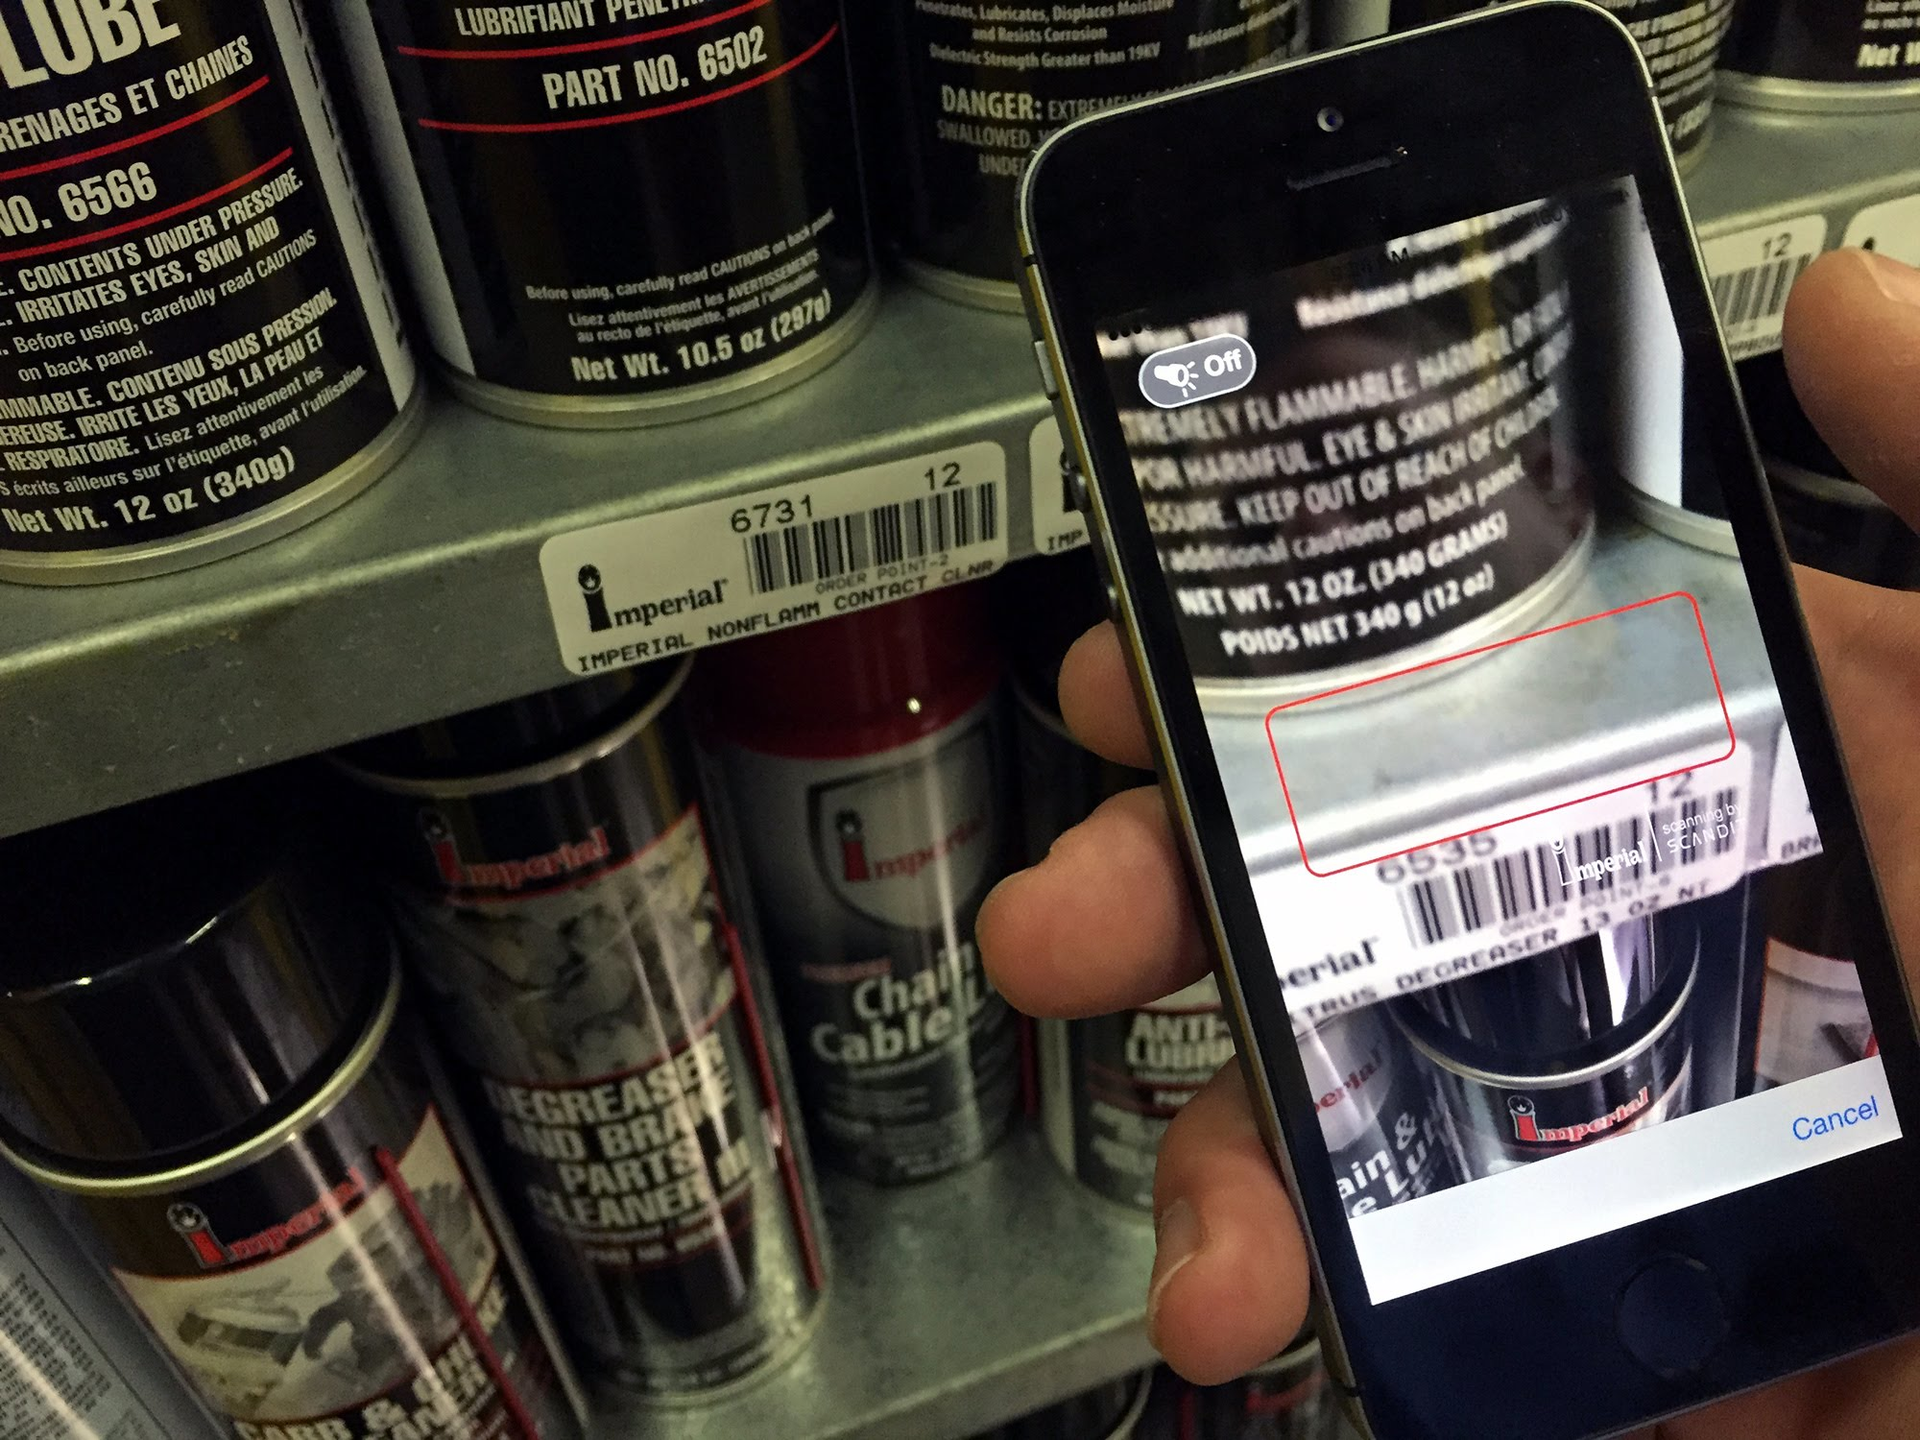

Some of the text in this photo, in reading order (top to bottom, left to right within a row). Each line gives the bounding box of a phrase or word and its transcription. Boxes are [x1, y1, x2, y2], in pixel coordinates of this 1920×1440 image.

[455, 0, 595, 36] LUBRIFIANT
[1044, 25, 1108, 43] Corrosion
[1052, 3, 1114, 23] Displaces
[0, 35, 253, 152] RENAGES ET CHAINES
[542, 25, 767, 109] PART NO. 6502
[1041, 52, 1091, 68] Greater
[941, 84, 1042, 120] DANGER:
[0, 161, 157, 238] NO. 6566
[18, 167, 303, 291] CONTENTS UNDER PRESSURE.
[15, 216, 279, 323] IRRITATES EYES, SKIN AND
[526, 286, 568, 300] Before
[572, 285, 614, 301] using,
[616, 274, 675, 297] carefully
[679, 267, 708, 287] read
[710, 245, 771, 278] CAUTIONS
[1763, 232, 1792, 260] 12
[13, 229, 316, 354] Before using, carefully read CAUTIONS
[569, 312, 605, 327] Lisez
[609, 297, 702, 324] attentivement
[18, 341, 154, 382] on back panel.
[106, 364, 206, 401] CONTENU
[208, 334, 260, 370] SOUS
[263, 287, 338, 340] PRESSION.
[571, 288, 832, 382] Net Wt. 10.5 oz (297g)
[1204, 349, 1243, 378] Off
[77, 410, 142, 437] IRRITE
[146, 395, 181, 423] LES
[187, 375, 240, 409] YEUX,
[242, 363, 266, 388] LA
[265, 343, 306, 378] PEAU
[302, 327, 324, 354] ET
[4, 364, 324, 472] RESPIRATOIRE. Lisez attentivement les
[13, 478, 60, 497] écrits
[63, 470, 129, 492] ailleurs
[133, 464, 161, 482] sur
[260, 413, 300, 441] avant
[2, 445, 296, 534] Net Wt. 12 oz (340g)
[731, 461, 962, 534] 6731 12
[1303, 475, 1356, 514] OUT
[1360, 464, 1391, 501] OF
[1177, 509, 1508, 617] NET WT. 12 OZ. (340 GRAMS)
[1292, 517, 1393, 560] cautions
[1395, 505, 1425, 534] on
[578, 559, 995, 673] IMPERIAL NONFLAMM CONTACT CLNR
[815, 574, 868, 595] ORDER
[1220, 563, 1495, 657] POIDS NET 340 g (12 oz)
[1376, 770, 1696, 884] 6535 12
[1662, 801, 1743, 836] scanning by
[1397, 928, 1559, 990] DEGREASER
[811, 1006, 953, 1063] Cable
[1792, 1095, 1879, 1141] Cancel
